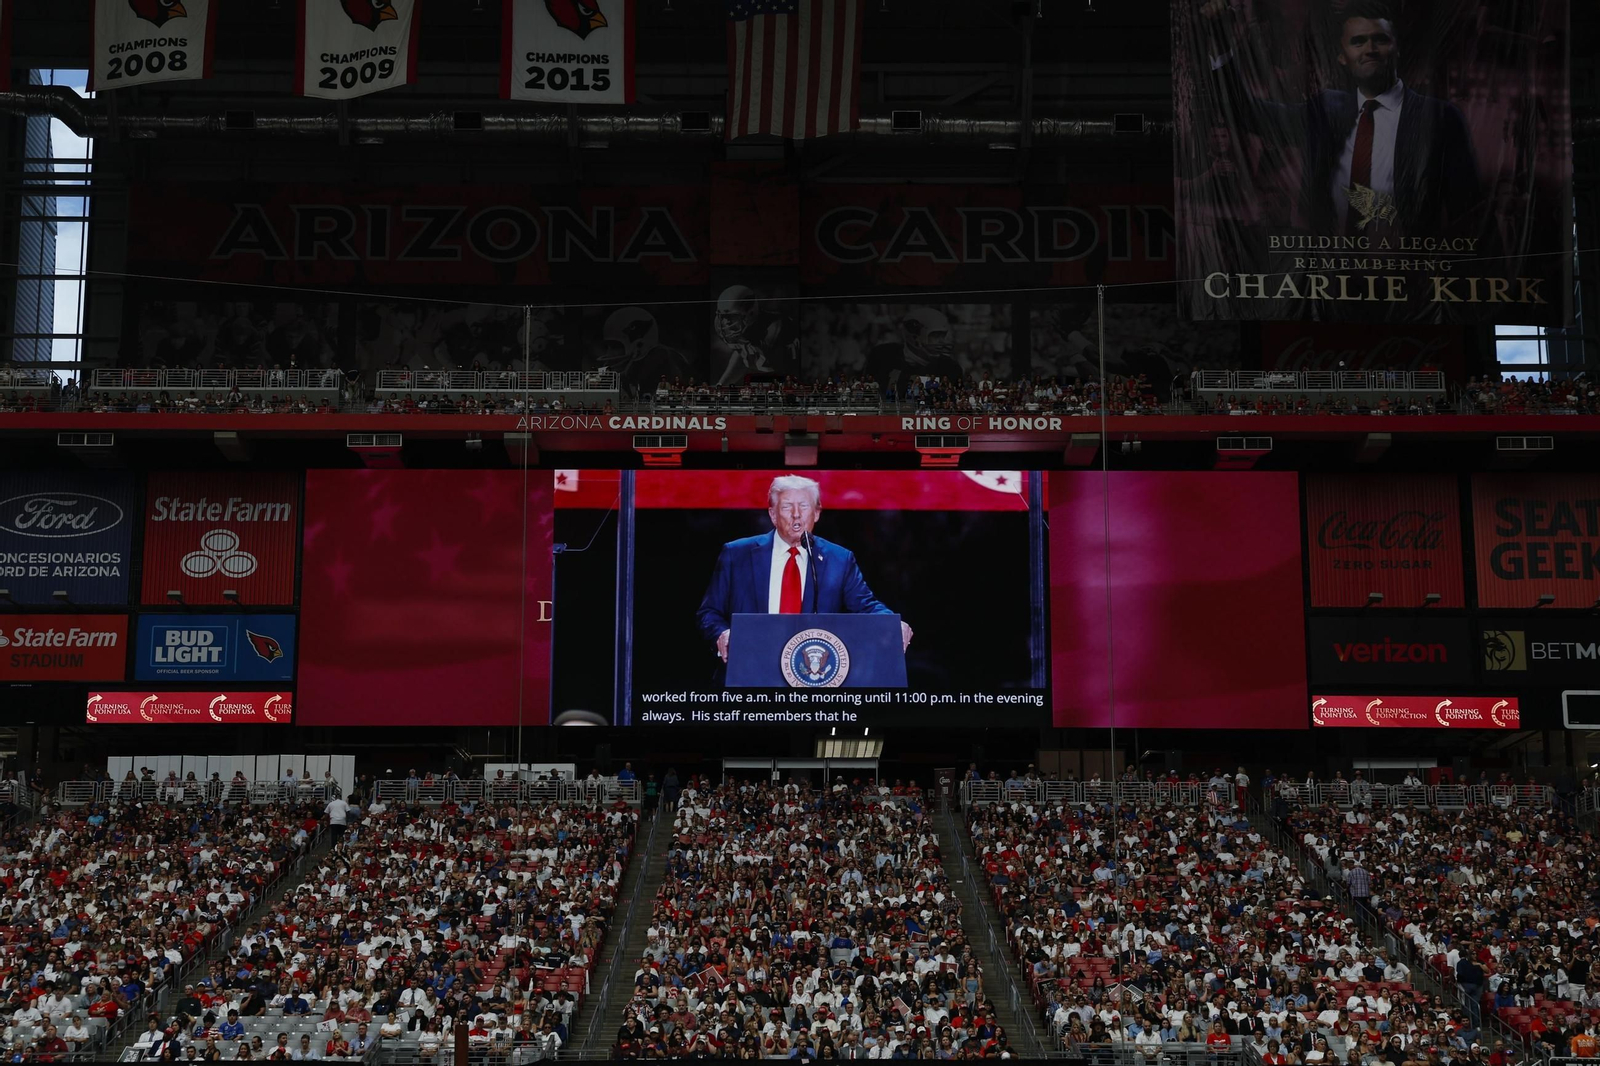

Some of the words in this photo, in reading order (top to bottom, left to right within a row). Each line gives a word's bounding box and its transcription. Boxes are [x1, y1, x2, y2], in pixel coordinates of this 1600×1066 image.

[109, 37, 188, 54] CHAMPIONS
[320, 46, 397, 64] CHAMPIONS
[526, 52, 610, 65] CHAMPIONS
[107, 50, 188, 80] 2008
[319, 58, 395, 89] 2009
[525, 66, 611, 91] 2015
[208, 203, 698, 264] ARIZONA
[1269, 235, 1371, 250] BUILDING
[1378, 236, 1392, 250] A
[1399, 237, 1479, 251] LEGACY
[1294, 257, 1453, 272] REMEMBERING
[1203, 272, 1409, 302] CHARLIE
[1429, 276, 1549, 305] KIRK
[516, 416, 602, 430] ARIZONA
[608, 416, 727, 430] CARDINALS
[902, 417, 951, 431] RING
[957, 417, 983, 431] OF
[989, 417, 1062, 431] HONOR
[15, 498, 98, 530] Ford
[1495, 498, 1600, 537] SEAT
[1333, 560, 1375, 570] ZERO
[1380, 560, 1432, 570] SUGAR
[1490, 542, 1600, 580] GEEK
[28, 566, 49, 578] DE
[52, 566, 121, 578] ARIZONA
[165, 630, 214, 646] BUD
[784, 632, 815, 660] PRESIDENT
[155, 646, 223, 663] LIGHT
[1333, 636, 1448, 664] verizon
[1531, 642, 1600, 660] BETM
[10, 653, 85, 668] STADIUM
[641, 691, 687, 703] worked
[689, 691, 718, 703] from
[722, 691, 743, 703] five
[745, 692, 772, 703] a.m.
[774, 691, 786, 703] in
[788, 692, 808, 703] the
[811, 691, 862, 706] morning
[864, 692, 892, 703] until
[895, 692, 927, 704] 11:00
[930, 693, 957, 706] p.m.
[959, 692, 971, 704] in
[973, 692, 994, 704] the
[996, 692, 1044, 707] evening
[641, 710, 686, 724] always.
[691, 710, 710, 722] His
[713, 710, 740, 722] staff
[743, 710, 812, 722] remembers
[814, 710, 839, 722] that
[842, 710, 858, 722] he
